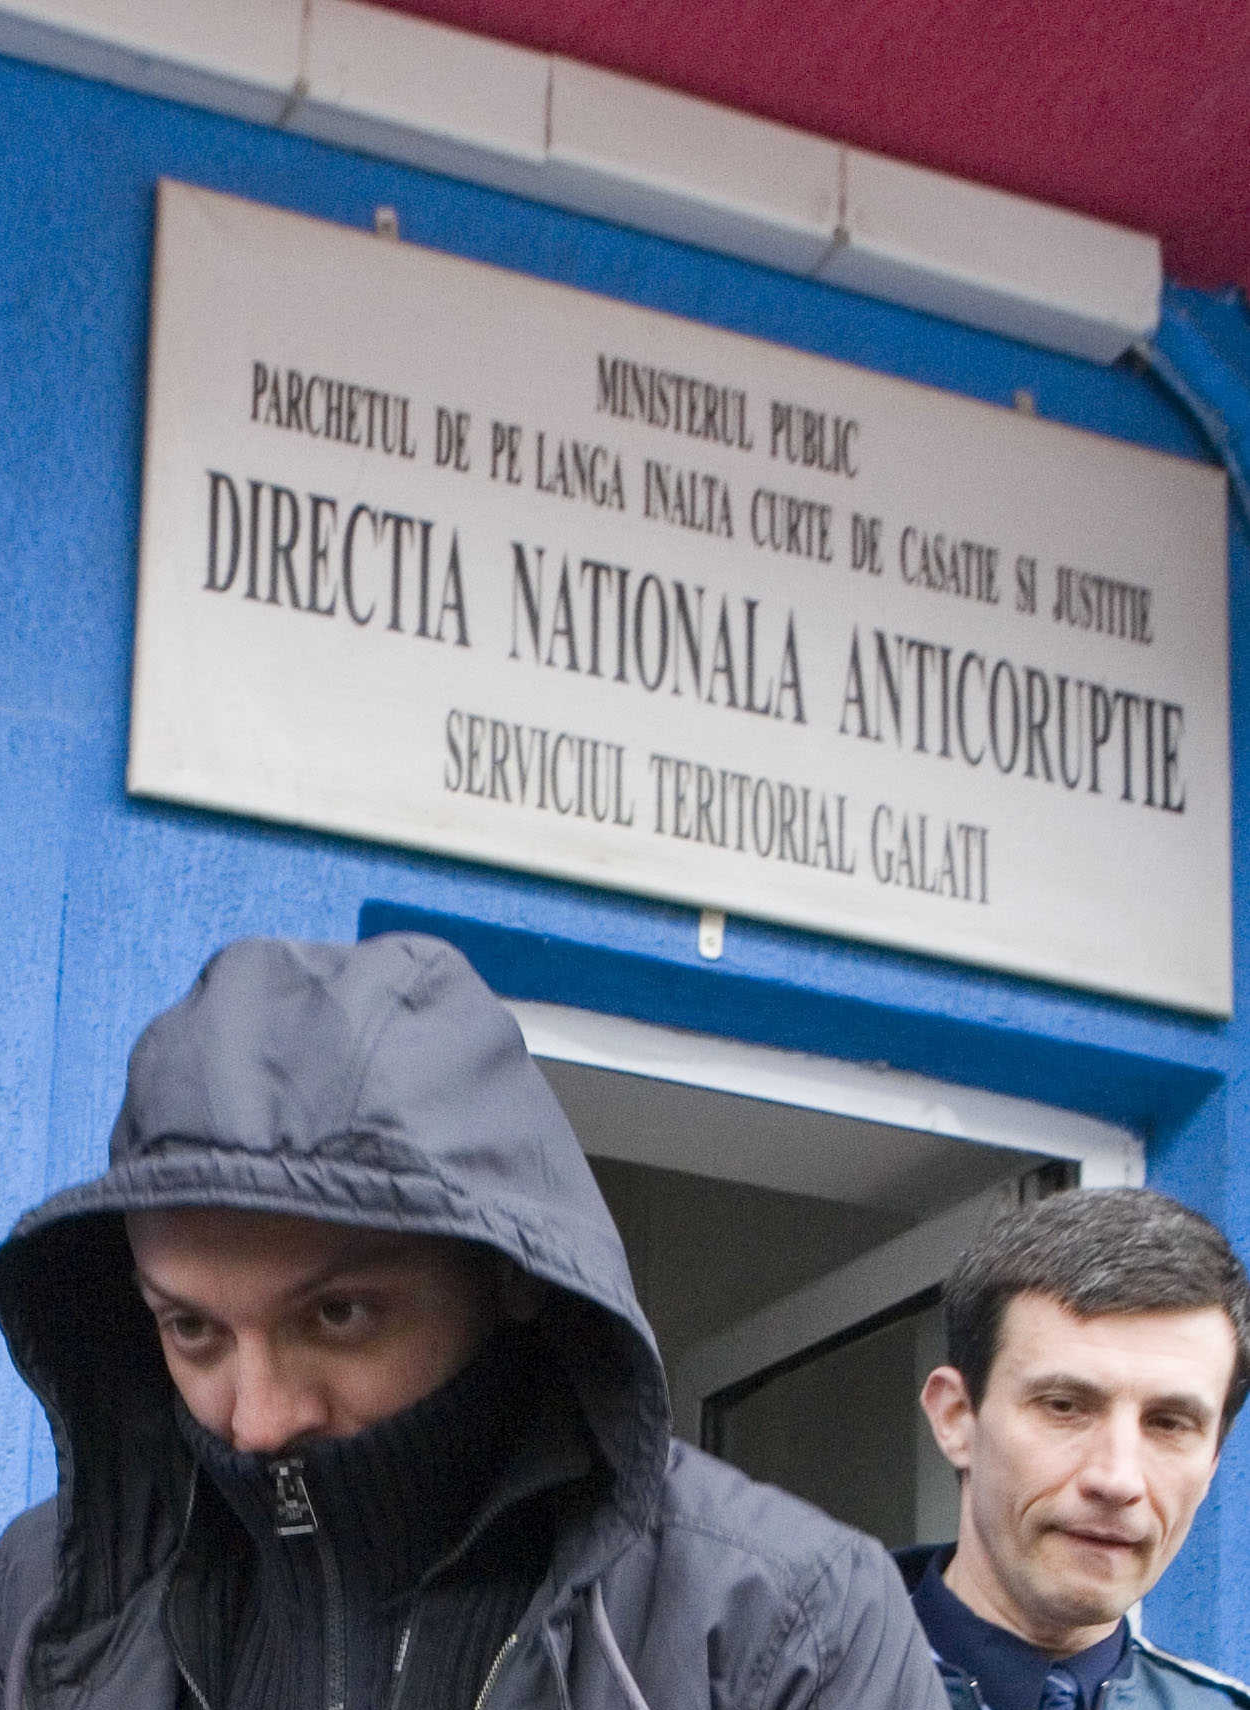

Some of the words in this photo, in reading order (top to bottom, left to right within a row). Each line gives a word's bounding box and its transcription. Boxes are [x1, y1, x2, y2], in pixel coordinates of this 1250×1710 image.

[251, 361, 415, 459] PARCHETUL
[435, 407, 470, 472] DE
[490, 421, 521, 485] PE
[536, 432, 625, 511] LANGA
[644, 460, 733, 538] INALTA
[751, 488, 832, 563] CURTE
[852, 513, 882, 575] DE
[900, 526, 998, 604] CASATIE
[1016, 556, 1036, 614] SI
[1053, 567, 1152, 644] JUSTITIE
[598, 355, 753, 451] MINISTERUL
[771, 401, 857, 478] PUBLIC
[204, 470, 470, 648] DIRECTIA
[509, 542, 807, 725] NATIONALA
[839, 623, 1185, 814] ANTICORUPTIE
[445, 709, 633, 827] SERVICIUL
[650, 754, 855, 875] TERITORIAL
[871, 805, 987, 904] GALATI
